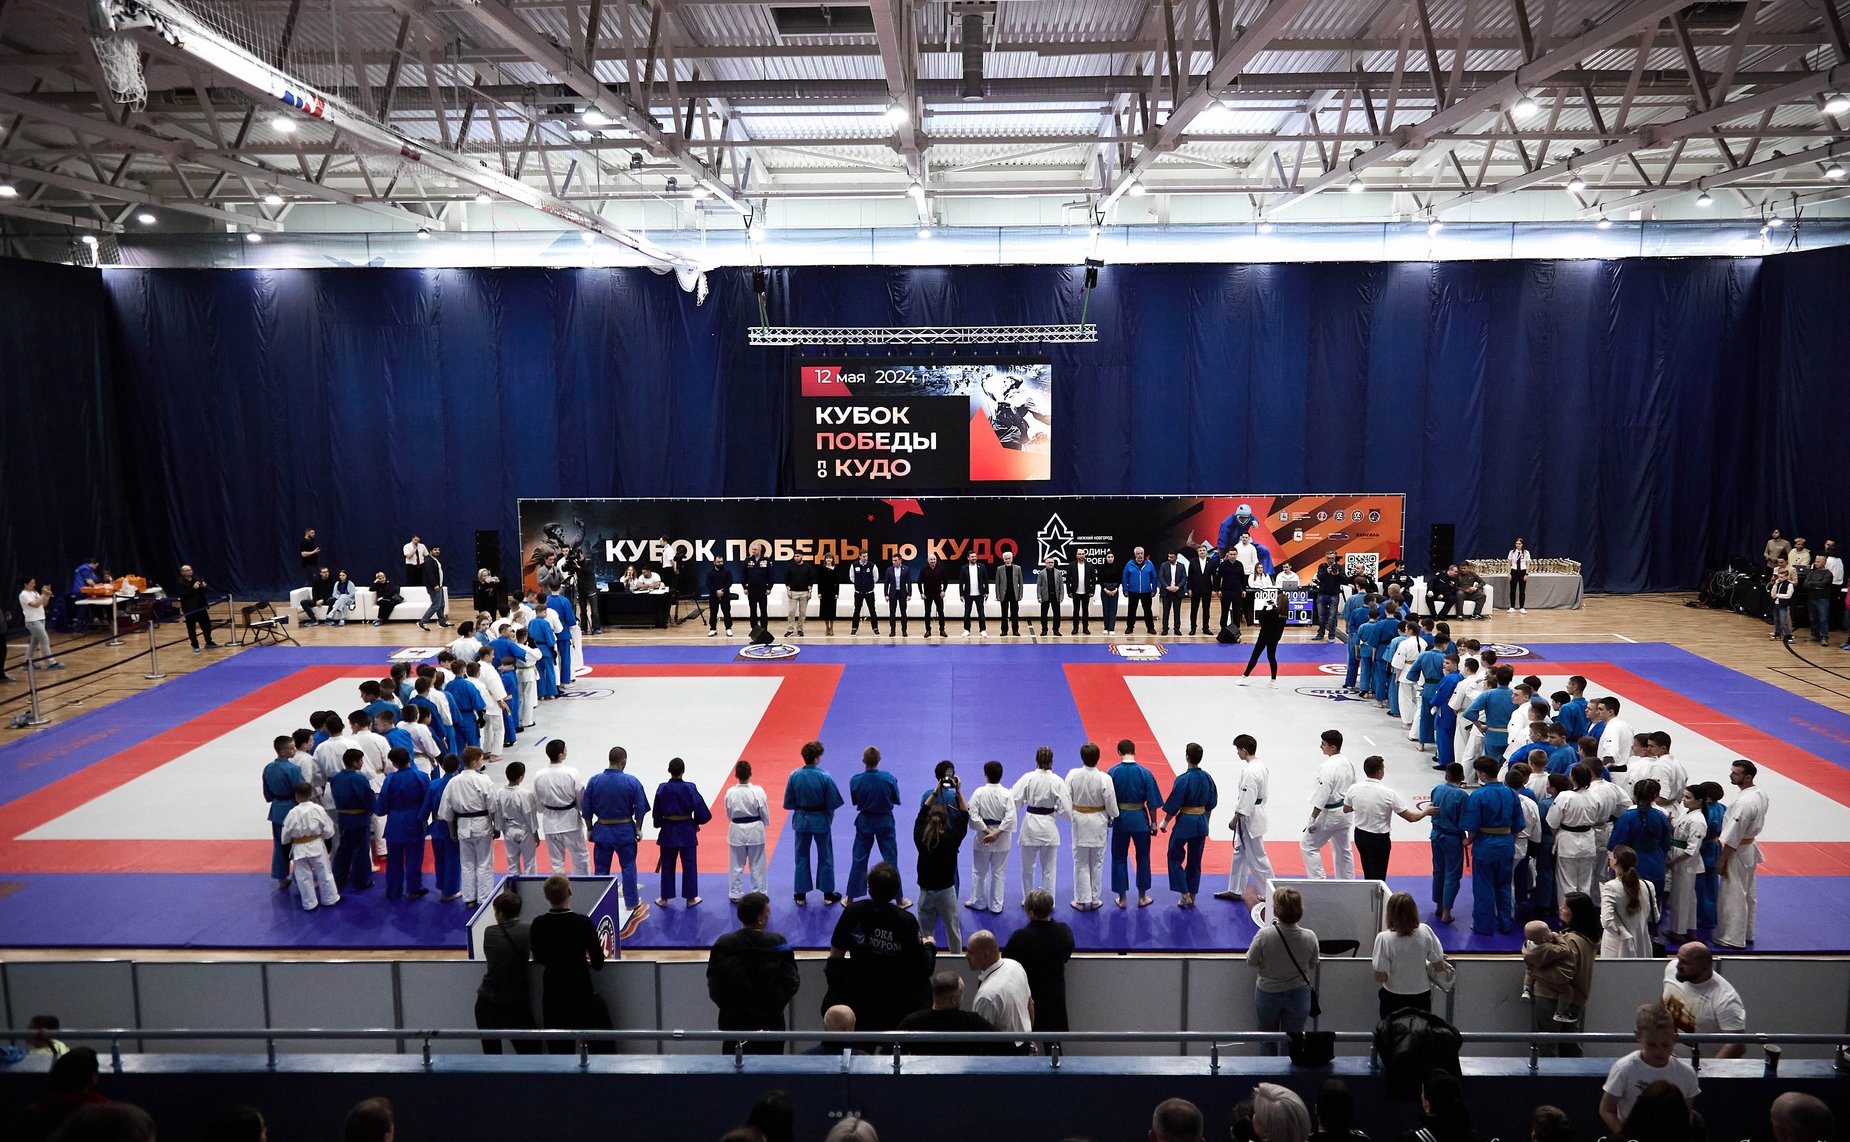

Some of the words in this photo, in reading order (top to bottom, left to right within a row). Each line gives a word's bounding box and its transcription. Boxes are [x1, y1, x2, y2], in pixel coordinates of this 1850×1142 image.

[815, 369, 832, 384] 12
[836, 373, 866, 384] мая
[875, 369, 918, 384] 2024
[815, 406, 910, 425] КУБОК
[816, 432, 937, 453] ПОБЕДЫ
[835, 459, 912, 480] КУДО
[726, 538, 869, 564] ПОБЕДЫ
[882, 543, 918, 561] по
[927, 538, 1019, 564] КУДО
[874, 928, 893, 941] ОКА
